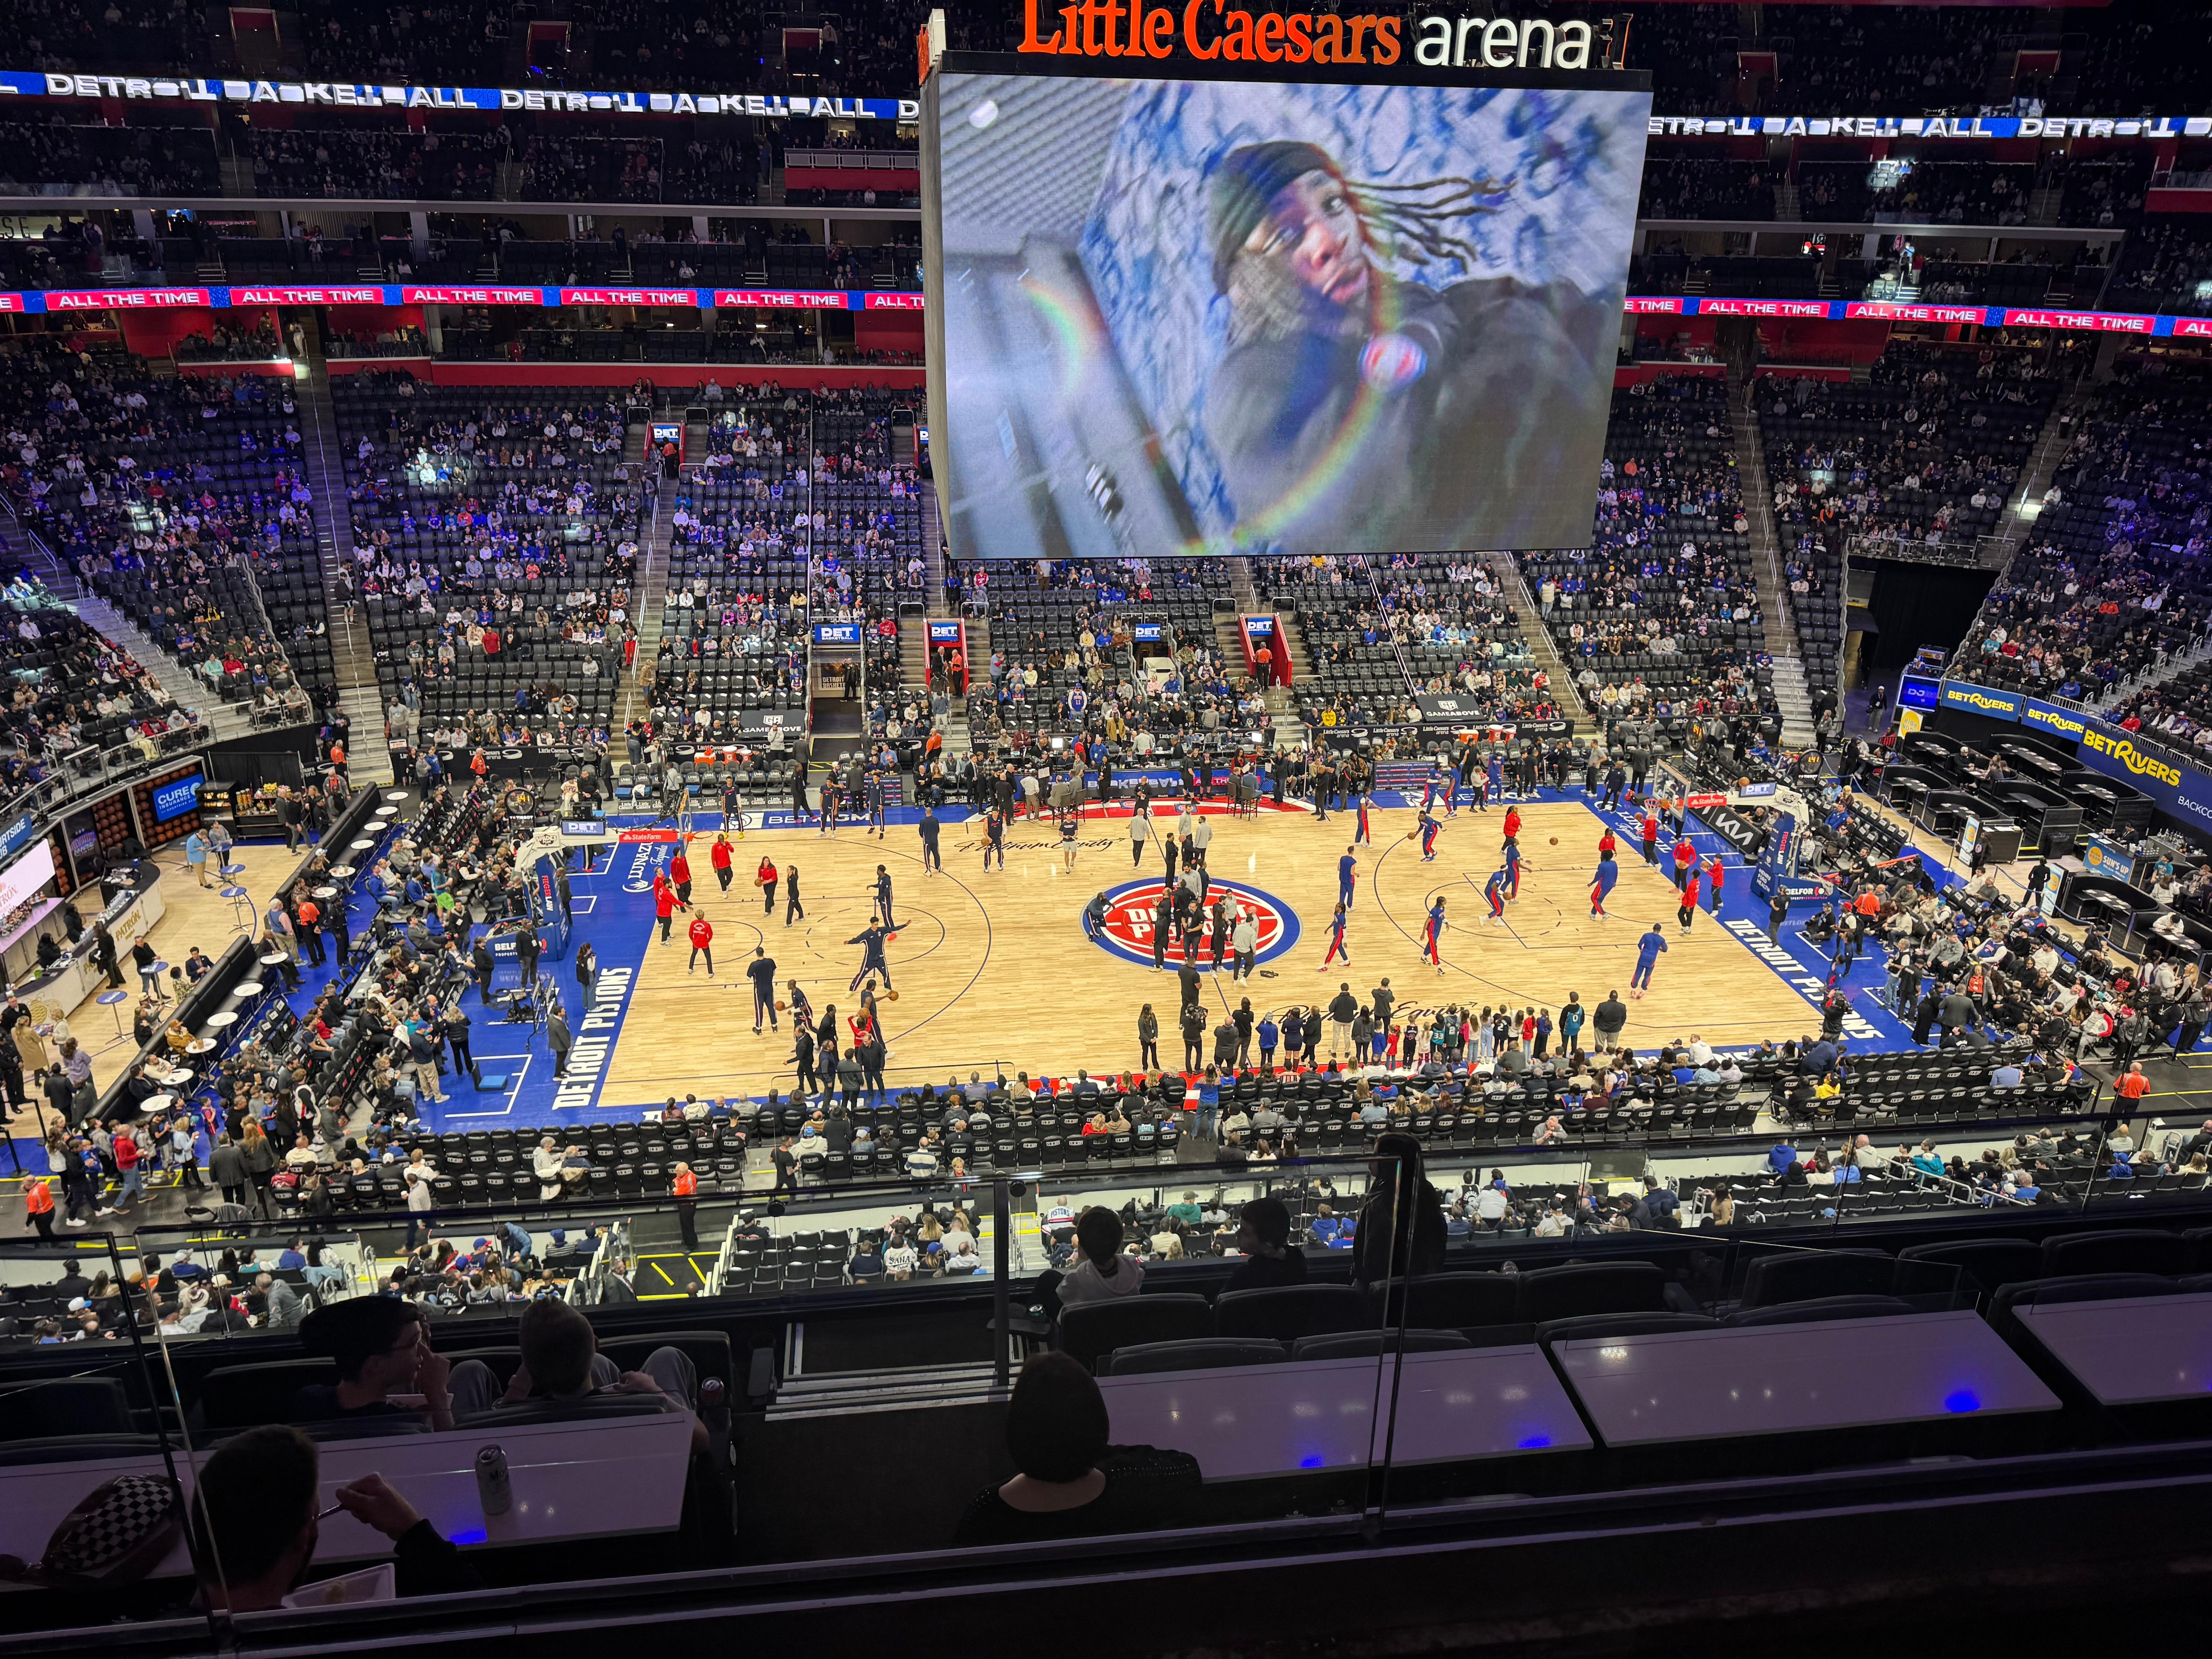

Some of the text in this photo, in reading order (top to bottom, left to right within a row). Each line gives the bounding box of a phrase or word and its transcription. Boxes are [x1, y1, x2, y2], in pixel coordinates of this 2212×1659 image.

[1018, 0, 1589, 69] Little Caesars arena
[59, 292, 199, 307] ALL THE TIME
[243, 291, 373, 303] ALL THE TIME
[414, 290, 534, 302] ALL THE TIME
[571, 292, 688, 304] ALL THE TIME
[724, 294, 839, 306] ALL THE TIME
[874, 296, 907, 307] ALL
[1640, 301, 1674, 311] TIME
[1708, 303, 1821, 315] ALL THE TIME
[1855, 306, 1976, 321] ALL THE TIME
[2014, 313, 2145, 330] ALL THE TIME
[2185, 323, 2212, 335] AL
[821, 627, 853, 637] DET
[1908, 688, 1925, 697] DJ
[1948, 691, 2014, 712] BETRIVERS
[2084, 730, 2181, 787] BETRIVERS
[157, 785, 190, 805] CURE
[159, 795, 191, 810] INSURANCE
[2103, 856, 2120, 871] SUN'S
[2120, 864, 2130, 875] UP
[1757, 874, 1767, 884] FORD
[1759, 868, 1771, 881] HENRY
[1756, 878, 1770, 893] HEALTH
[115, 910, 141, 941] PATRÓN
[495, 942, 516, 951] BELF
[1724, 919, 1809, 972] DETROIT
[1572, 1014, 1578, 1022] 0
[1449, 1026, 1455, 1035] 2
[1497, 1023, 1504, 1031] 2
[552, 967, 633, 1110] DETROIT PISTONS
